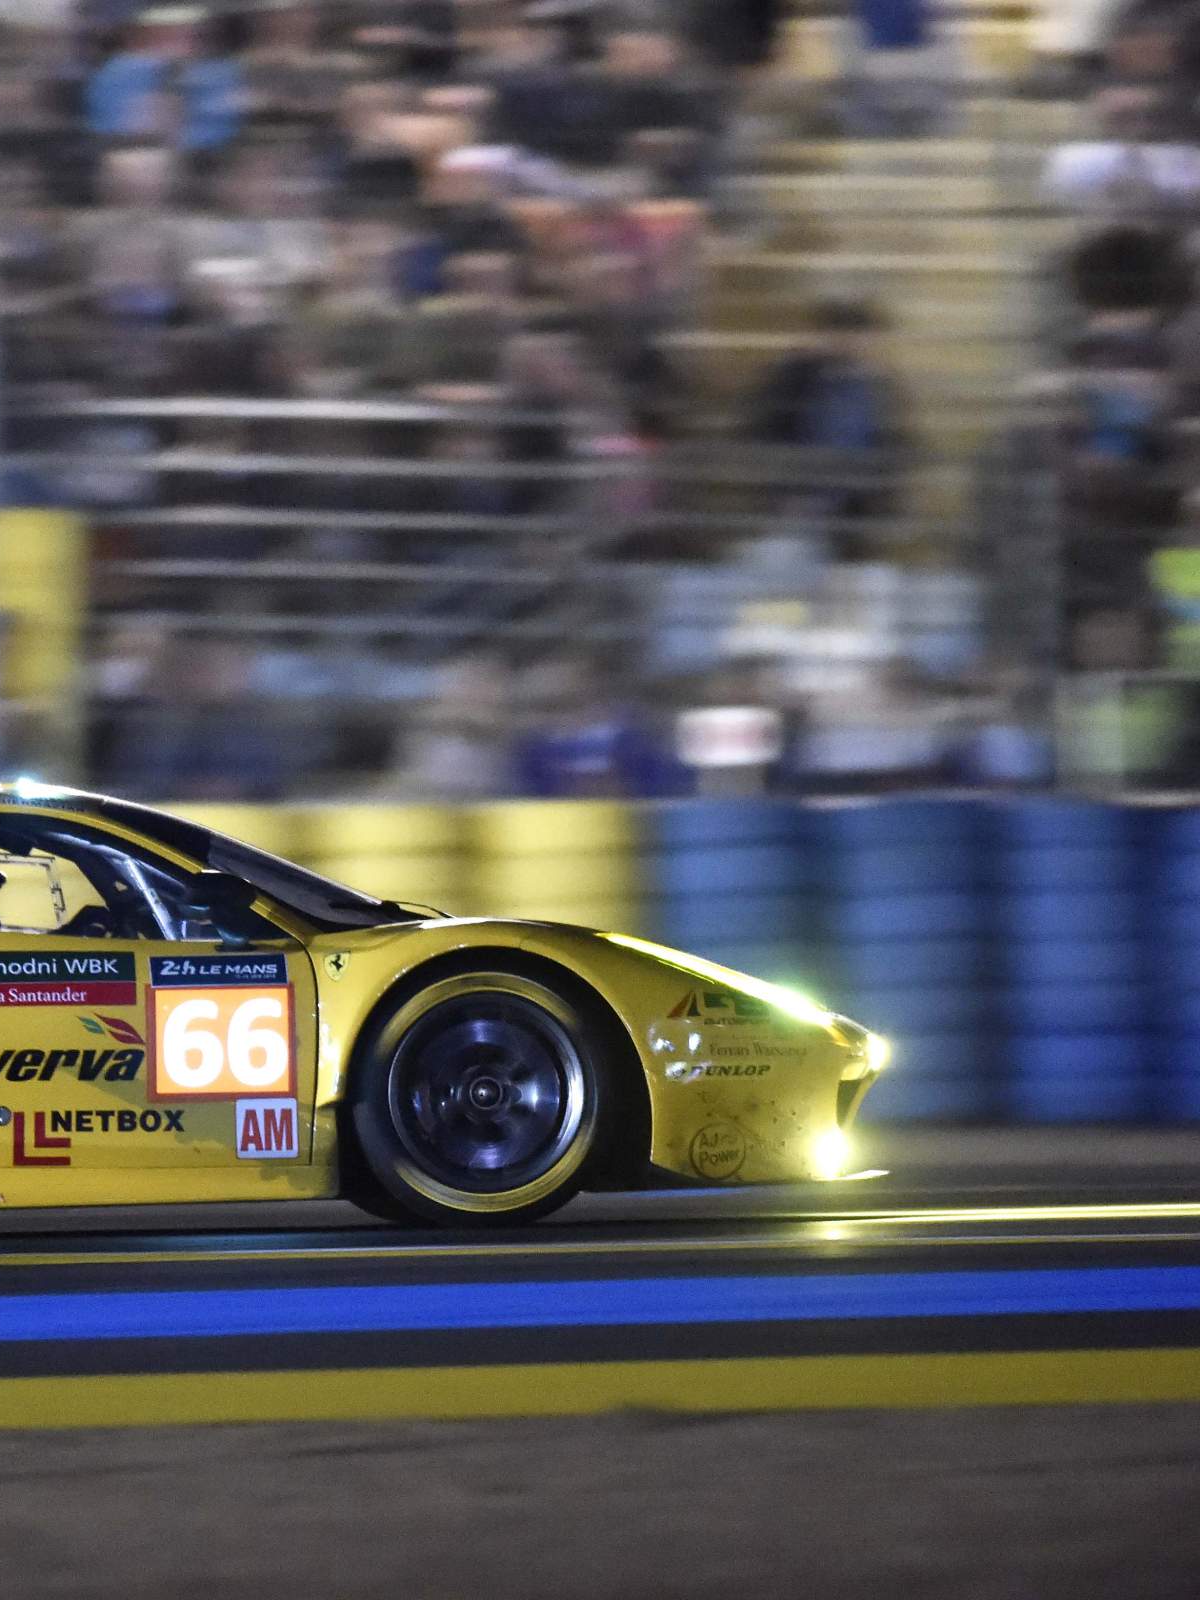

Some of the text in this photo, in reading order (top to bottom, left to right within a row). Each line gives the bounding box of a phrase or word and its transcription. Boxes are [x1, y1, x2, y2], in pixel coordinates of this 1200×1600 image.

[64, 958, 119, 975] WBK
[199, 965, 222, 975] LE
[225, 963, 278, 974] MANS
[8, 987, 87, 1003] Santander
[163, 998, 288, 1088] 66
[51, 1110, 185, 1133] NETBOX
[240, 1108, 294, 1151] AM
